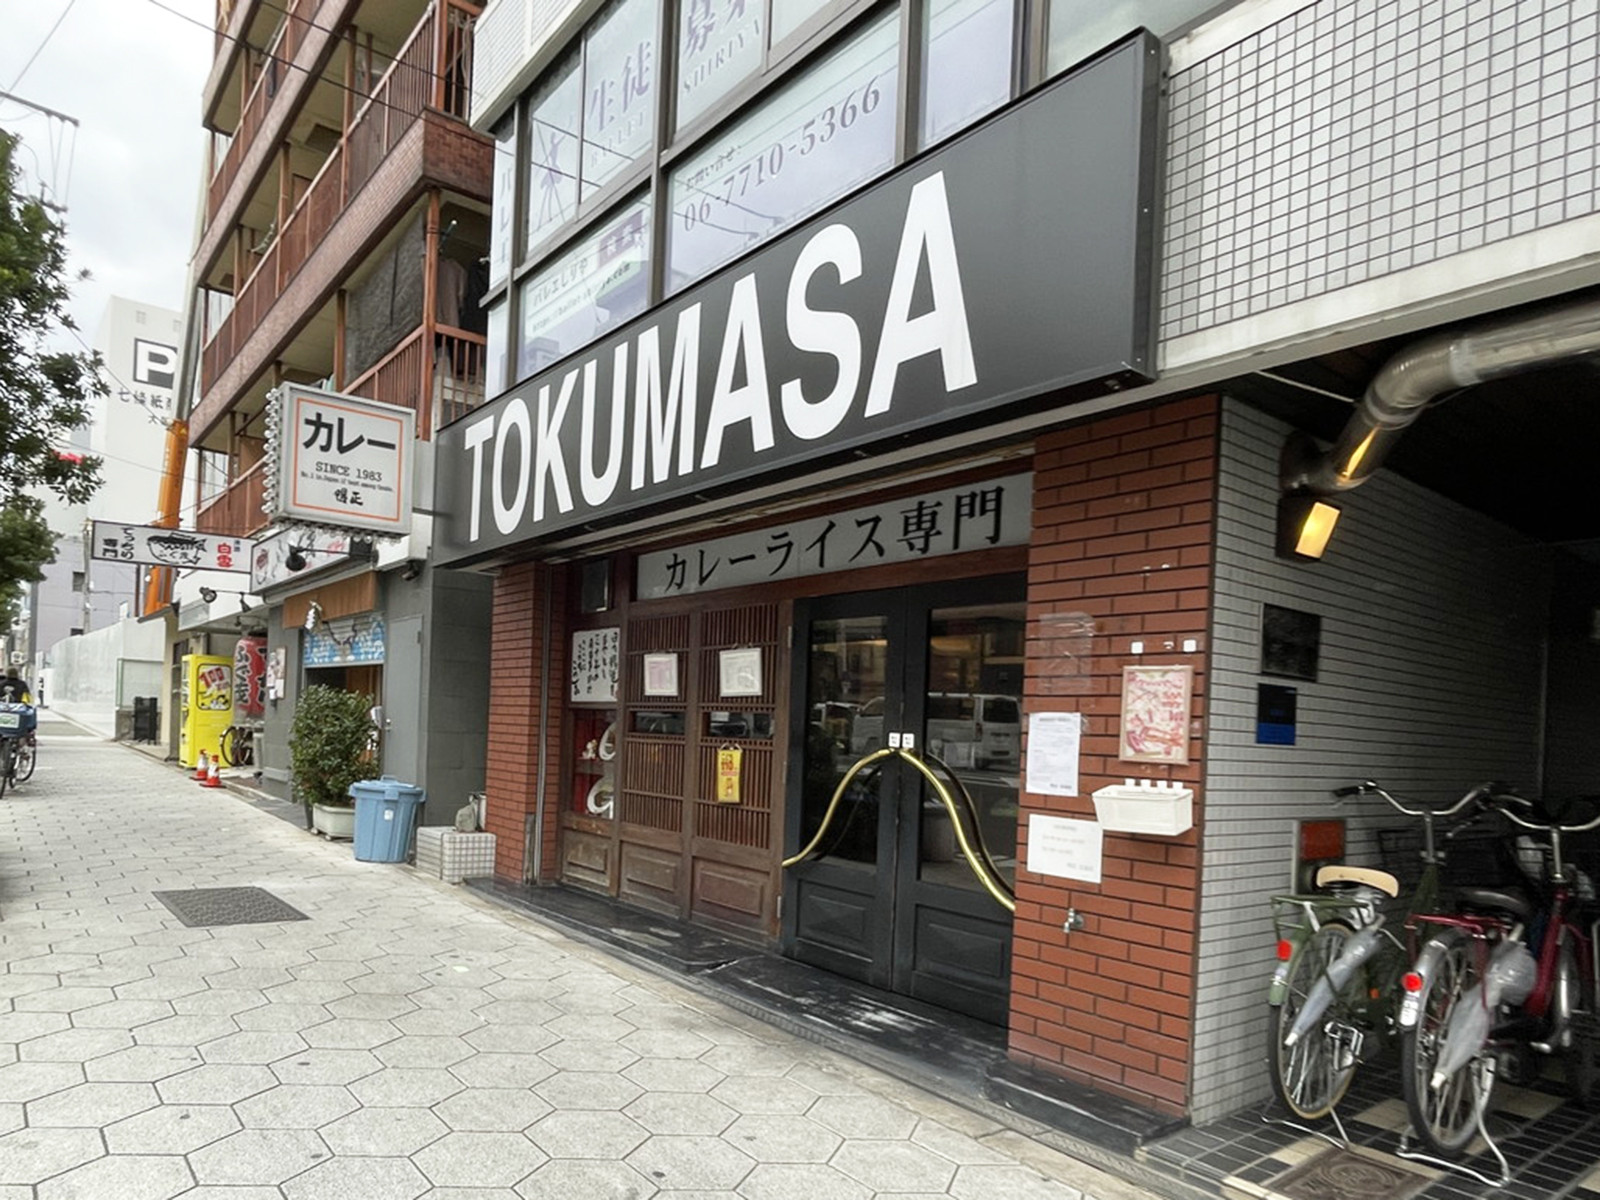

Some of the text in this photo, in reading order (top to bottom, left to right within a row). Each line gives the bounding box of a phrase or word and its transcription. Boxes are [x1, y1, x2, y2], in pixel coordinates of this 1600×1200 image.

[588, 41, 651, 132] 生徒
[683, 74, 881, 232] 06-7710-5366
[136, 340, 178, 382] P
[464, 170, 978, 542] TOKUMASA
[302, 411, 396, 454] カレー
[315, 460, 383, 482] SINCE 1983
[664, 486, 1005, 592] カレーライス専門
